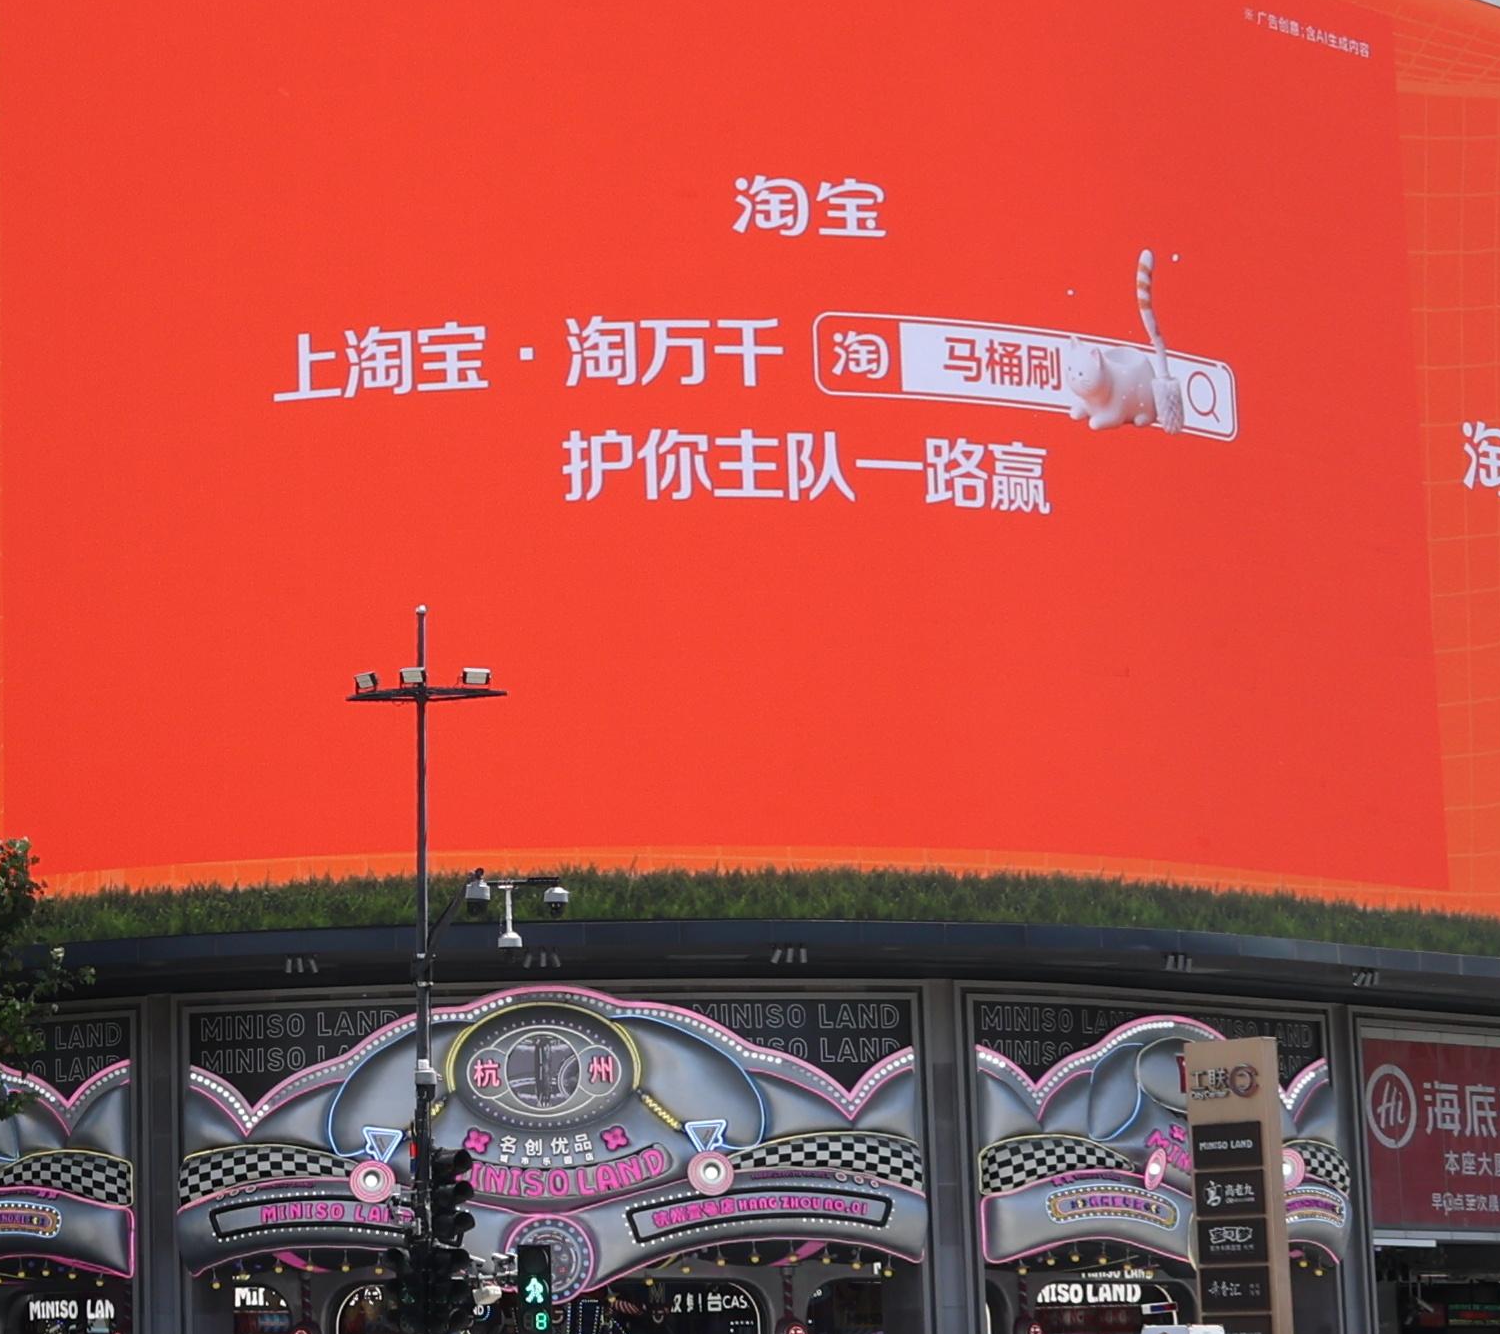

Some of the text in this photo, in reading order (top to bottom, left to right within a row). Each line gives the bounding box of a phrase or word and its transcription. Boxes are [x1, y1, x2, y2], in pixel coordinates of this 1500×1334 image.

[732, 174, 887, 238] 淘宝
[830, 330, 889, 380] 淘
[943, 336, 1063, 392] 马桶刷
[562, 428, 1052, 515] 护你主队一路赢
[201, 1013, 305, 1042] MINISO
[818, 1004, 901, 1029] LAND
[980, 1005, 1072, 1034] MINISO
[55, 1022, 123, 1050] LAND
[473, 1055, 614, 1088] 杭 州
[1192, 1068, 1229, 1089] 工联
[1377, 1081, 1406, 1130] Hi
[500, 1132, 593, 1158] 名创优品
[1199, 1139, 1253, 1151] MINISO LAND
[456, 1148, 665, 1198] INISO LAND
[261, 1203, 345, 1224] MINISO
[780, 1195, 821, 1211] ZHOU
[1086, 1283, 1142, 1303] LAND
[29, 1299, 78, 1322] MINISO
[535, 1313, 548, 1331] 8
